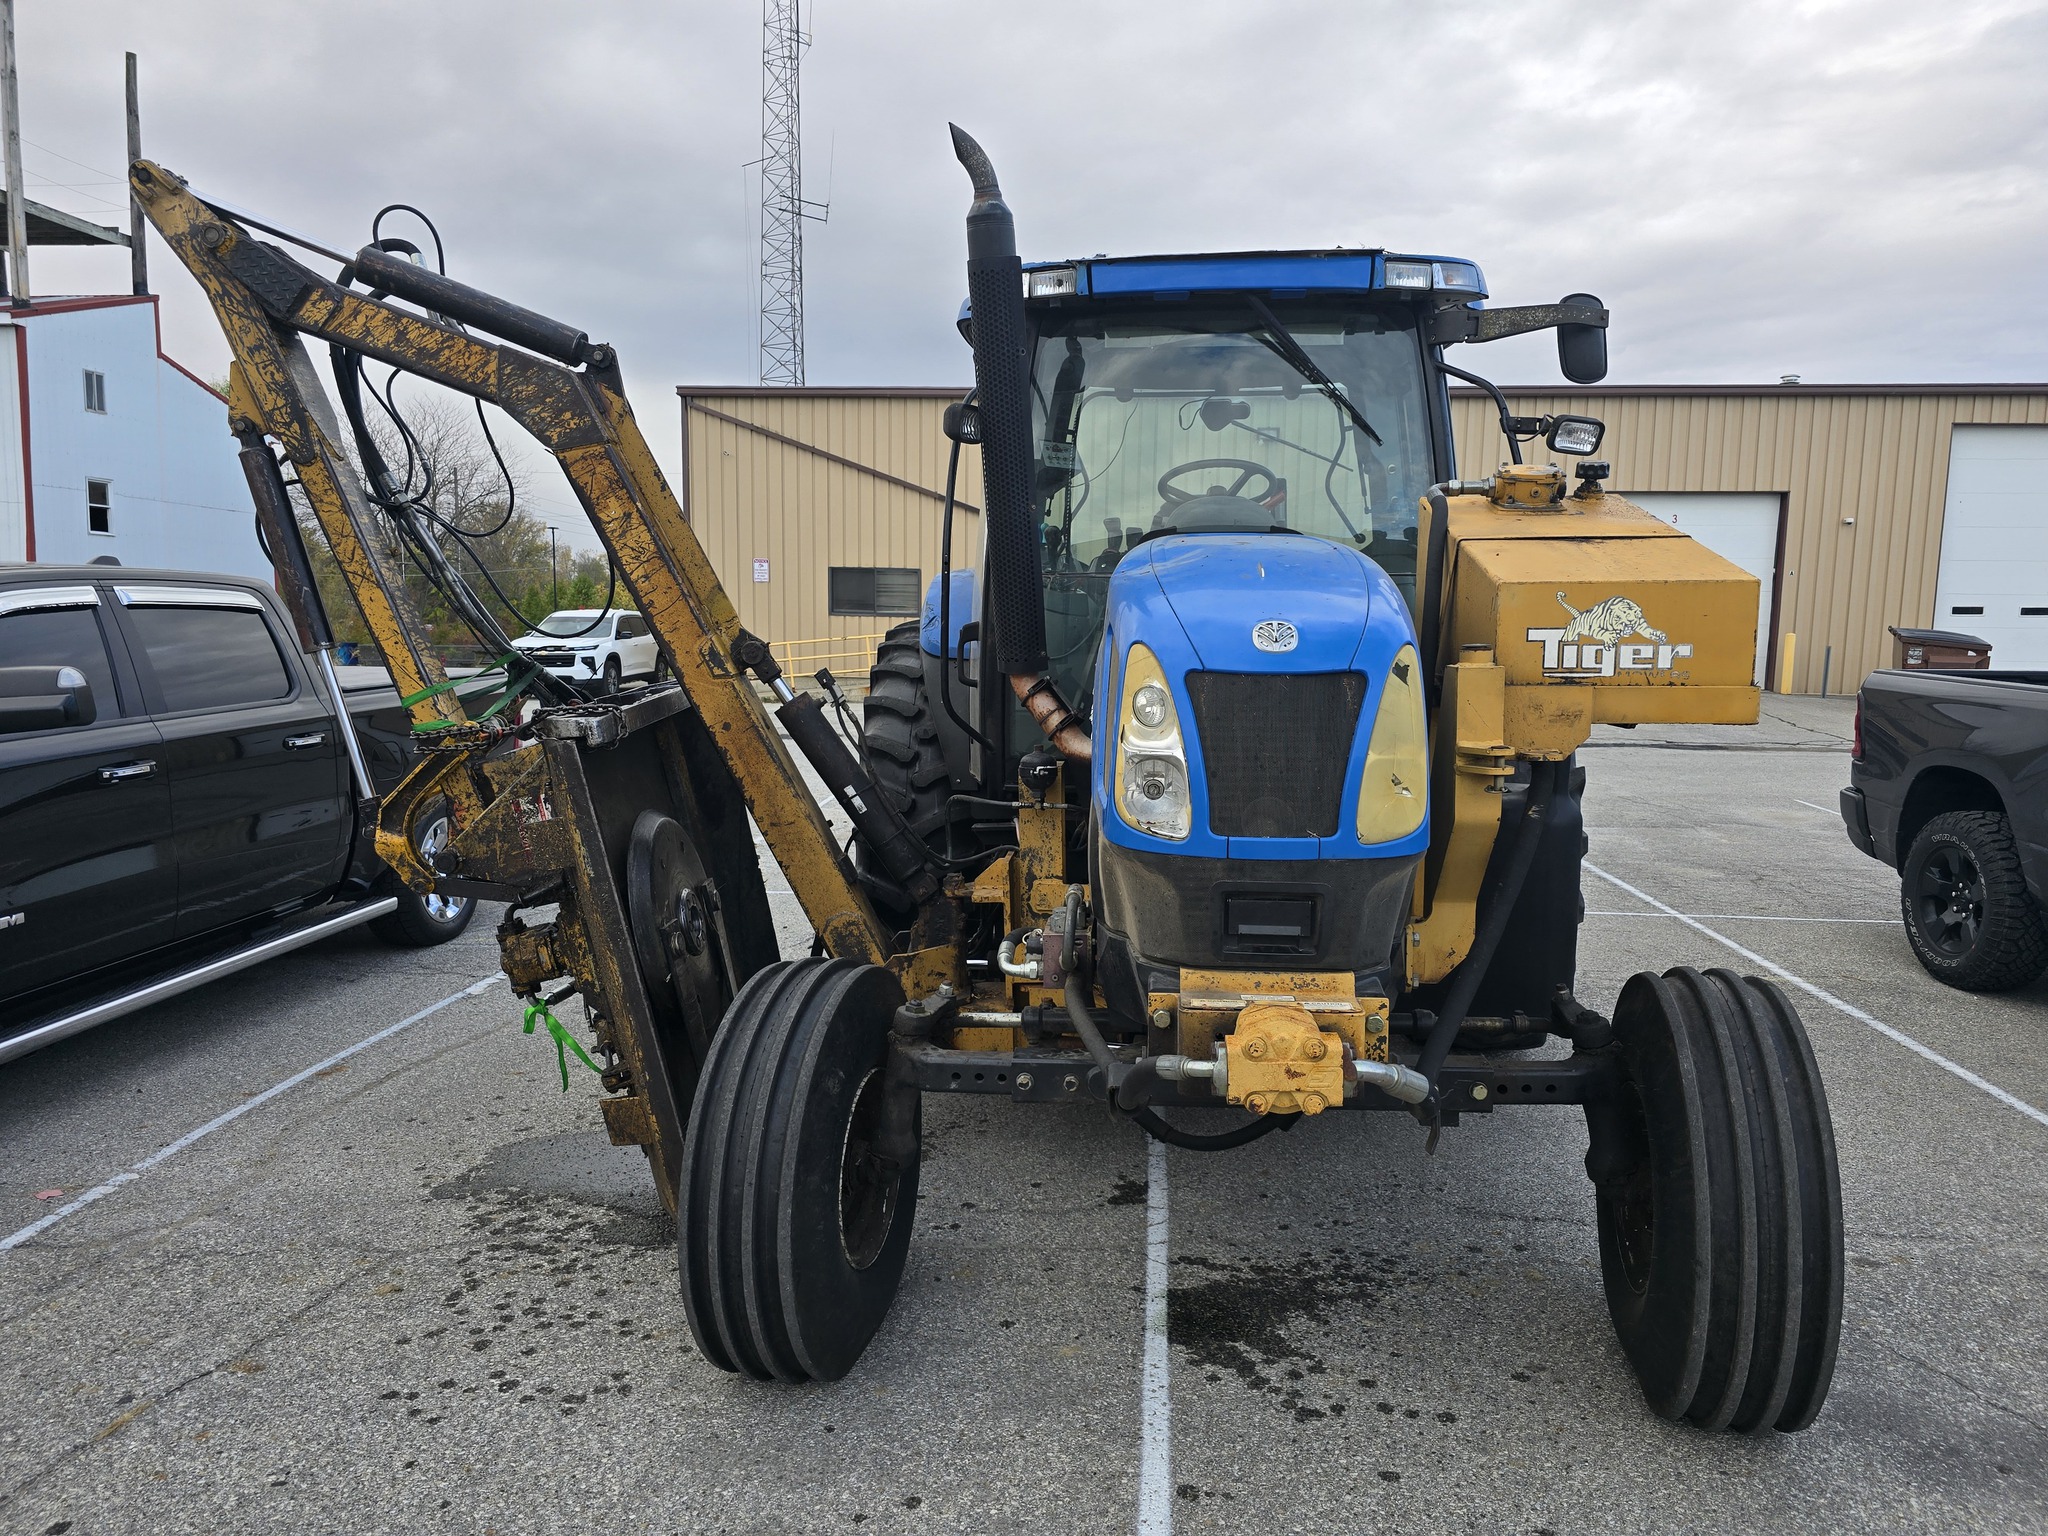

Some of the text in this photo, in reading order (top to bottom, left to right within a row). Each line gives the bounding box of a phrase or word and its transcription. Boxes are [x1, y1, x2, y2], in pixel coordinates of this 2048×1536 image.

[1671, 514, 1678, 524] 3
[1527, 628, 1693, 677] Tiger
[1931, 833, 1987, 899] WRANGLER
[1905, 897, 1960, 967] GOODYEAR
